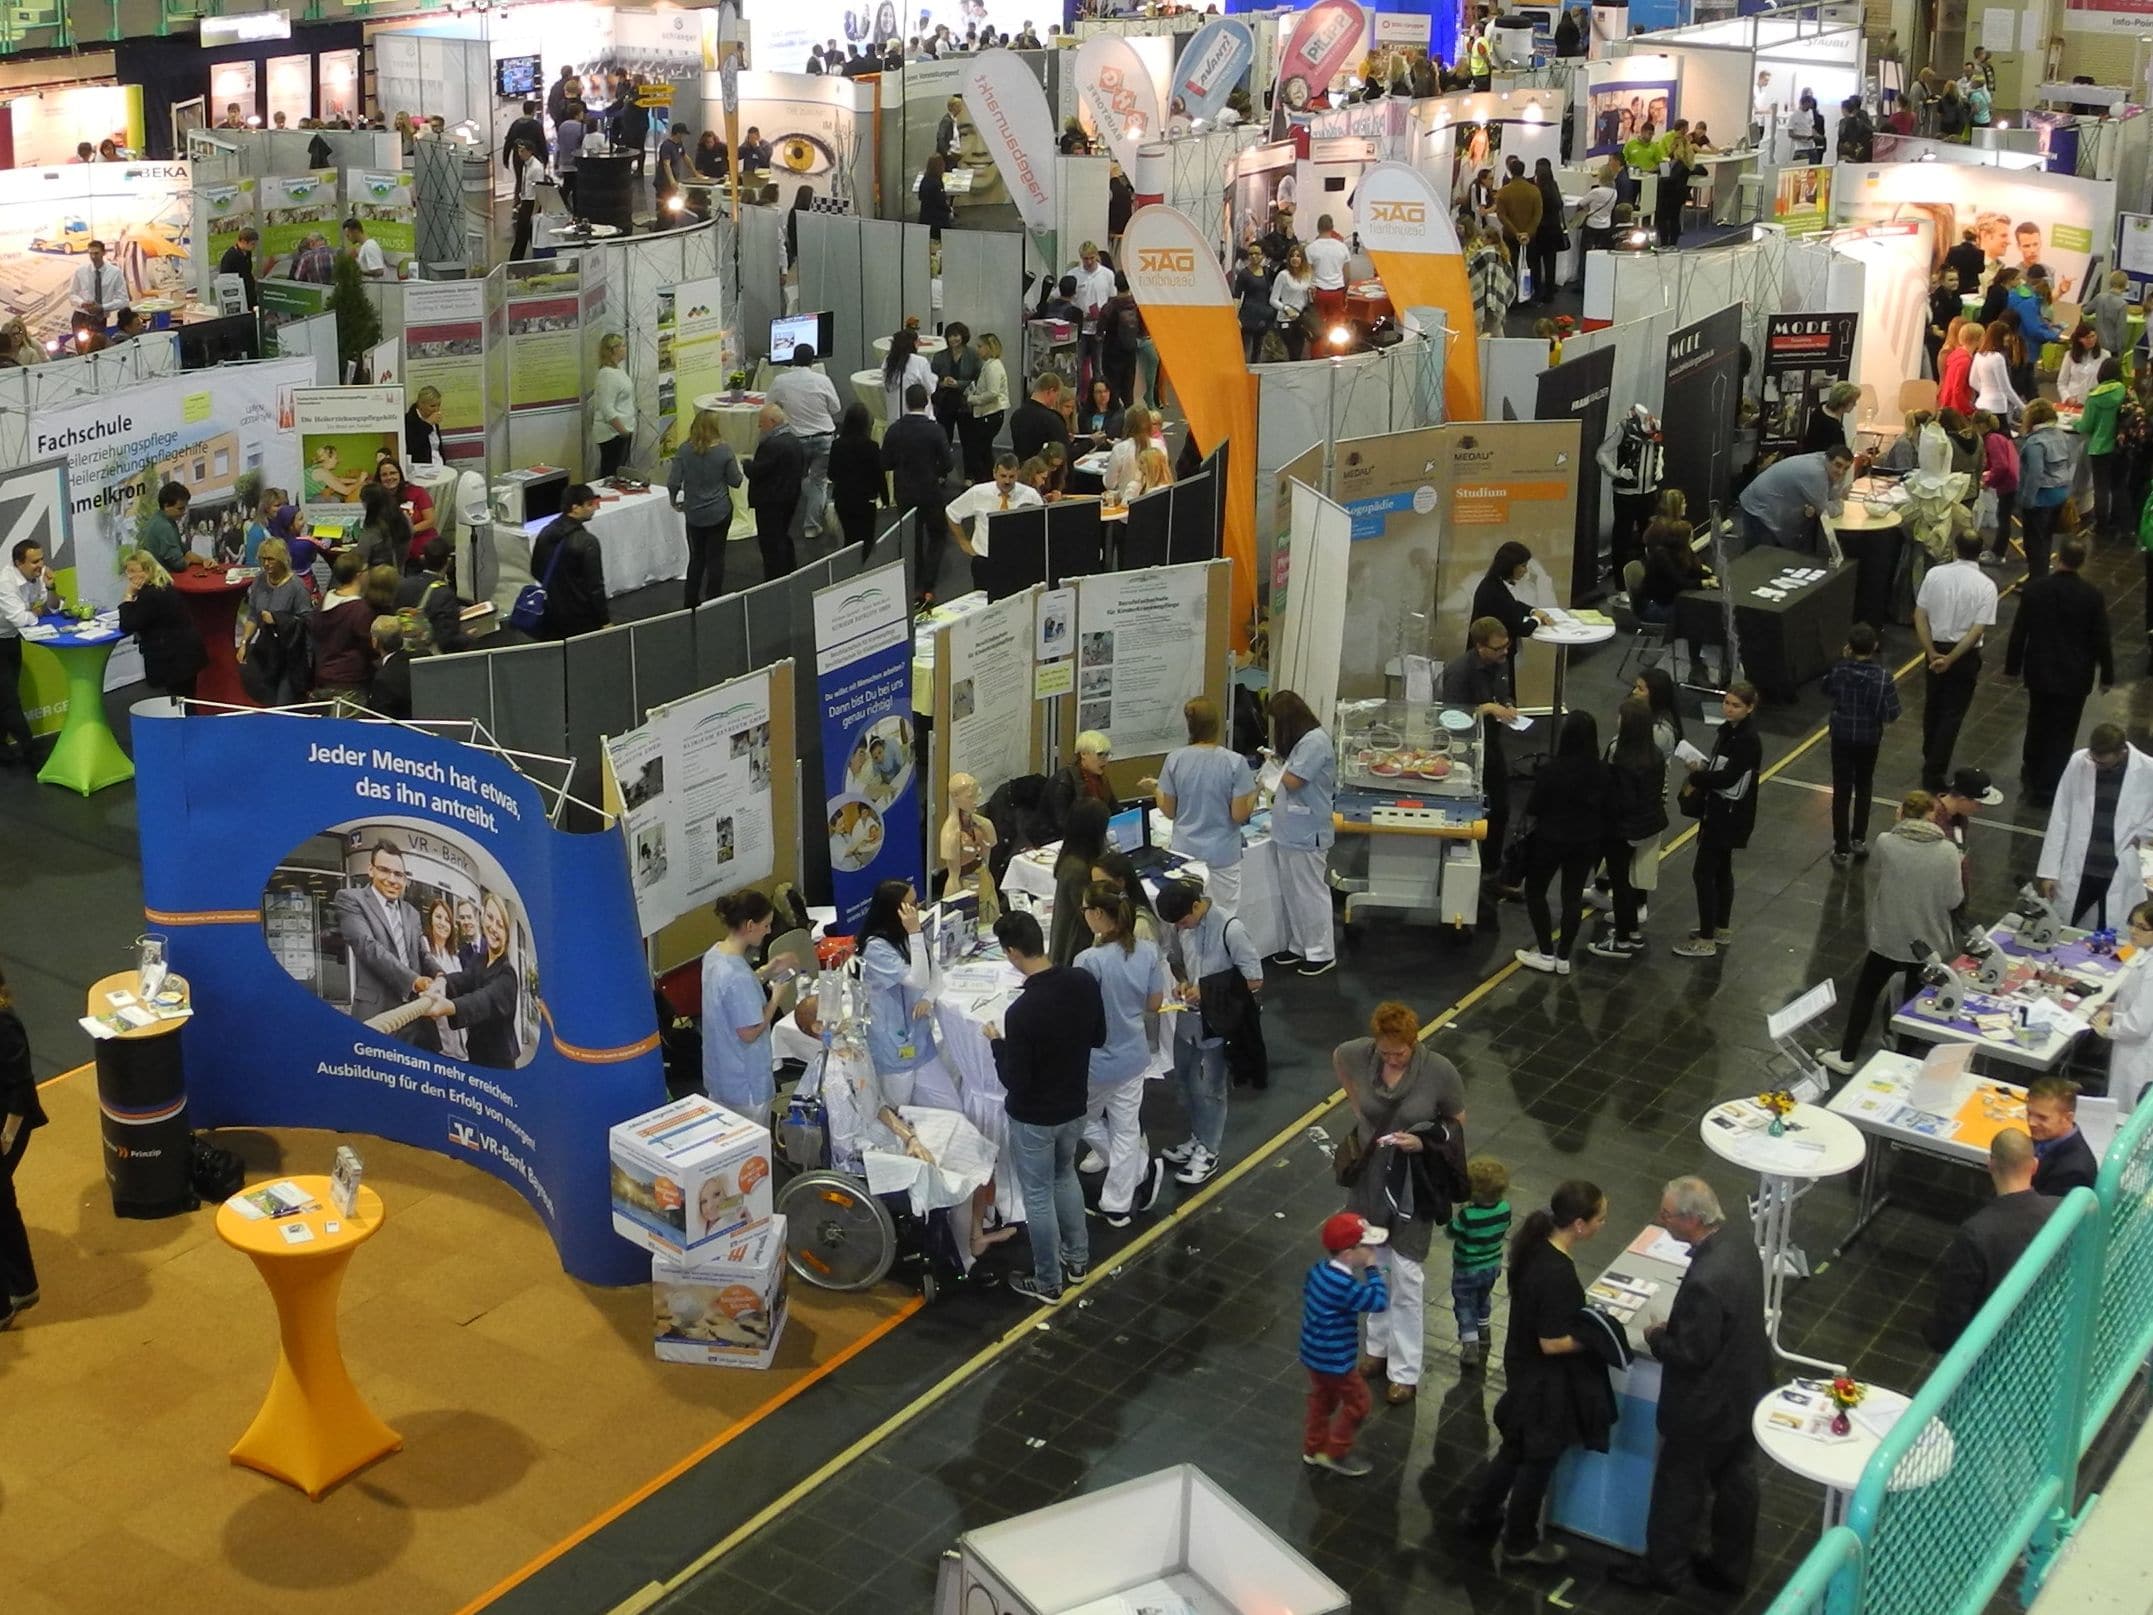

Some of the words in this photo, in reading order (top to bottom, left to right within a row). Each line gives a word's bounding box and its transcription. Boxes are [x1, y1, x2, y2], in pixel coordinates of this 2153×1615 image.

[141, 166, 188, 178] BEKA
[1772, 321, 1833, 335] MODE
[38, 415, 132, 453] Fachschule
[68, 430, 178, 469] eilerziehungspflege
[1455, 487, 1507, 498] Studium
[829, 700, 851, 718] Dann
[851, 695, 864, 709] bist
[866, 690, 877, 702] Du
[878, 681, 890, 695] bei
[891, 678, 904, 690] uns
[842, 710, 867, 729] genau
[867, 695, 893, 716] richtig!
[308, 743, 366, 767] Jeder
[372, 749, 445, 783] Mensch
[449, 766, 477, 793] hat
[480, 783, 522, 821] etwas,
[356, 776, 391, 800] das
[397, 782, 426, 808] ihn
[431, 795, 499, 834] antreibt.
[407, 833, 429, 850] VR
[442, 846, 469, 870] Bank
[353, 1042, 431, 1072] Gemeinsam
[433, 1063, 466, 1082] mehr
[317, 1061, 396, 1088] Ausbildung
[399, 1074, 418, 1091] für
[421, 1081, 446, 1099] den
[449, 1089, 483, 1115] Erfolg
[485, 1104, 504, 1124] von
[131, 1149, 162, 1159] Prinzip
[480, 1133, 527, 1177] VR-Bank
